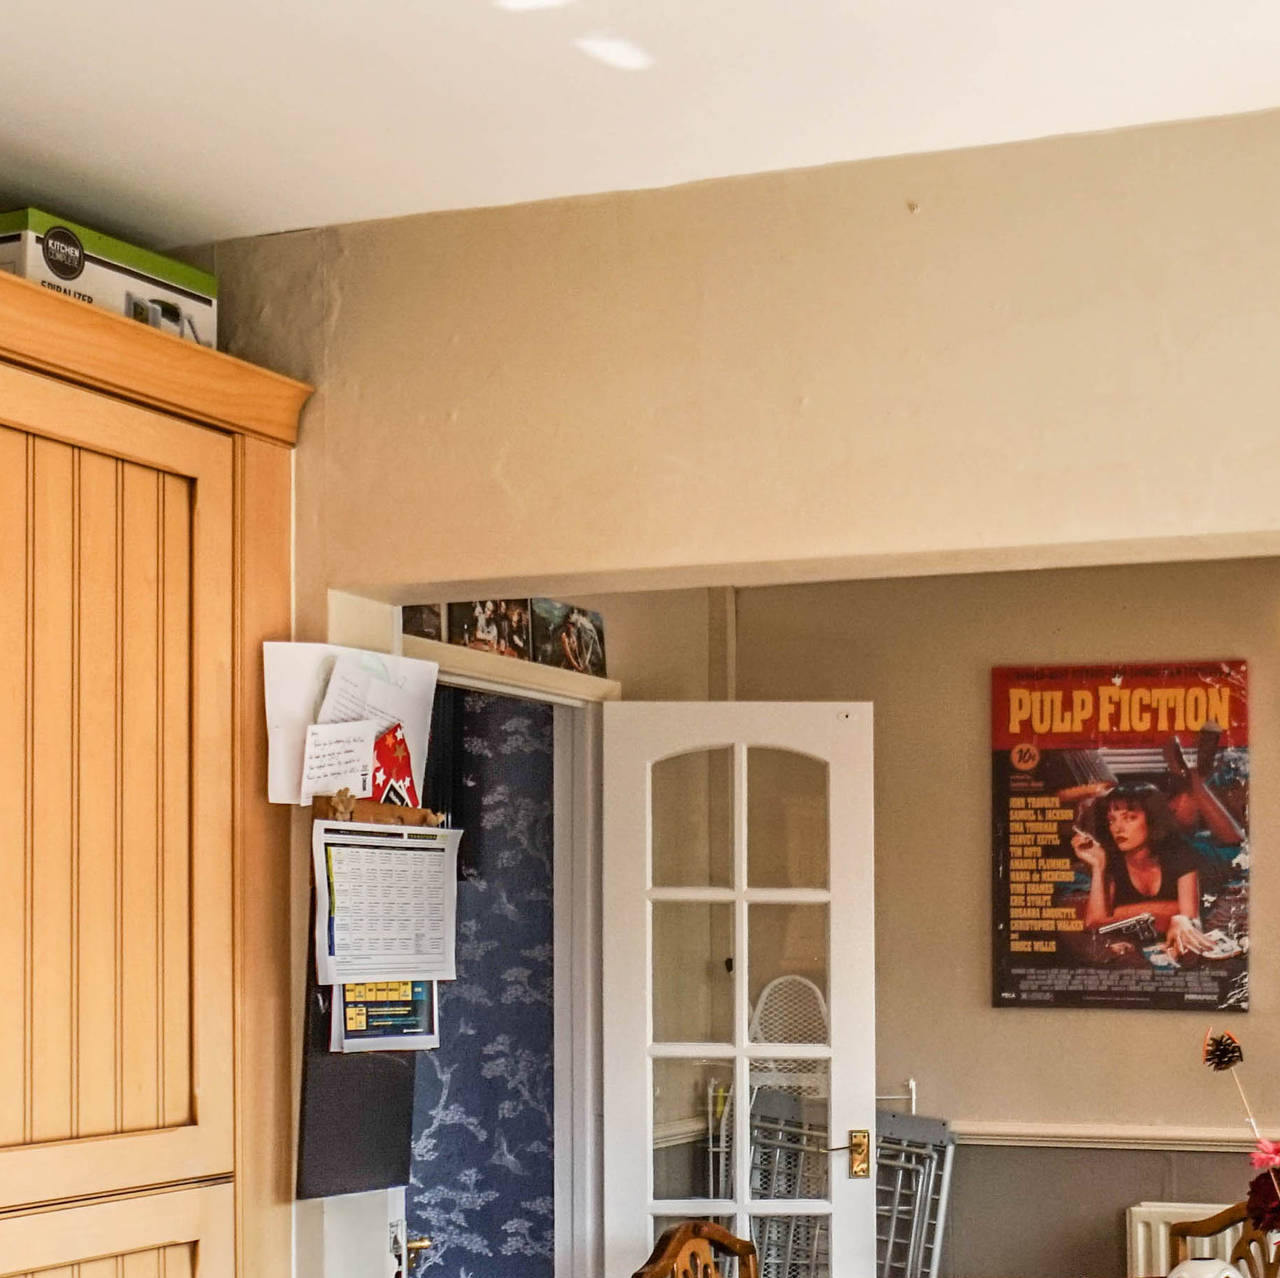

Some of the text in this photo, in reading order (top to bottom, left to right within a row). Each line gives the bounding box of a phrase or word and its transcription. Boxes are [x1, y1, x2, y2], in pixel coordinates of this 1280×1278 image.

[48, 239, 80, 257] KITCHEN
[1009, 685, 1231, 733] PULP FICTION
